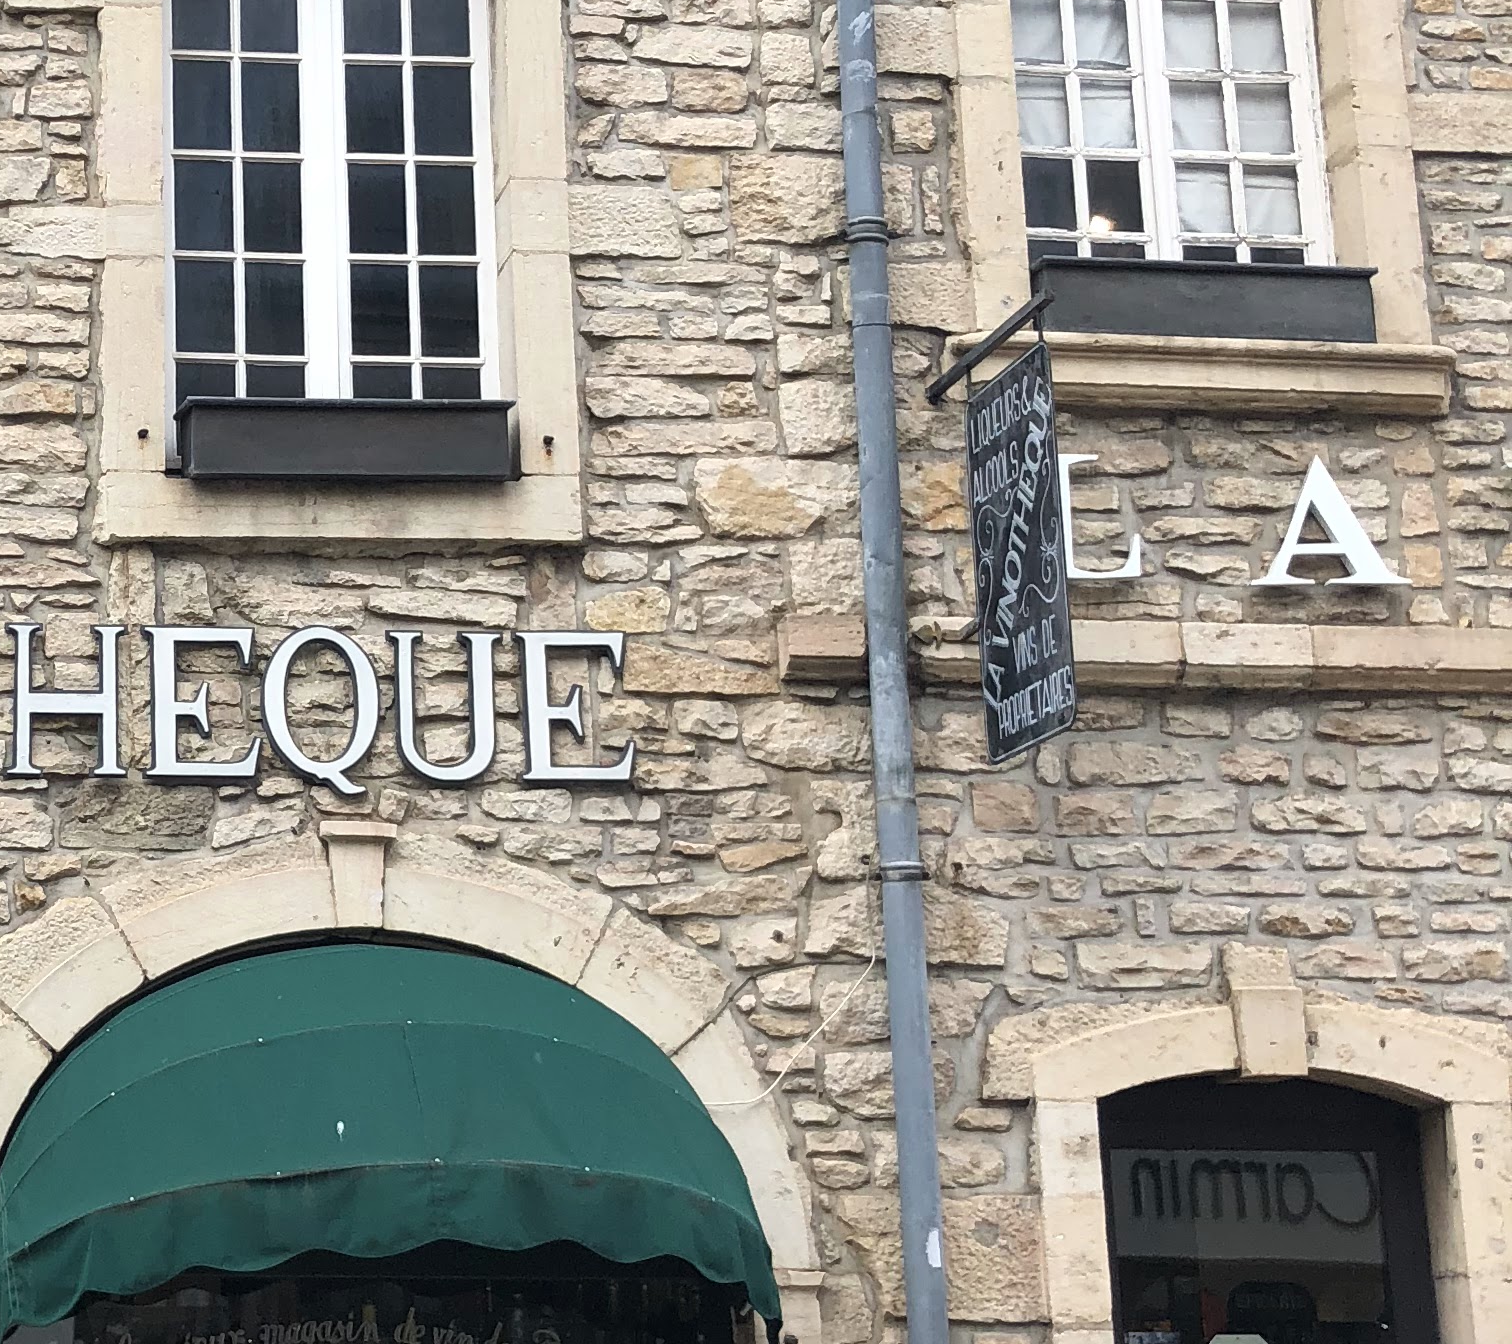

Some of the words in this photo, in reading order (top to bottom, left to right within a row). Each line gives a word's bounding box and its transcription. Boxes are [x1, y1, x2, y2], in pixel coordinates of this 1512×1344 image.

[970, 382, 1021, 454] LIQUEURS
[1021, 375, 1032, 416] &
[973, 440, 1019, 508] ALCOOLS
[991, 375, 1053, 648] VINOTHEQUE
[1011, 625, 1038, 674] VINS
[1041, 614, 1058, 659] DE
[983, 662, 1005, 712] LA
[997, 664, 1073, 740] PROPRIETAIRES
